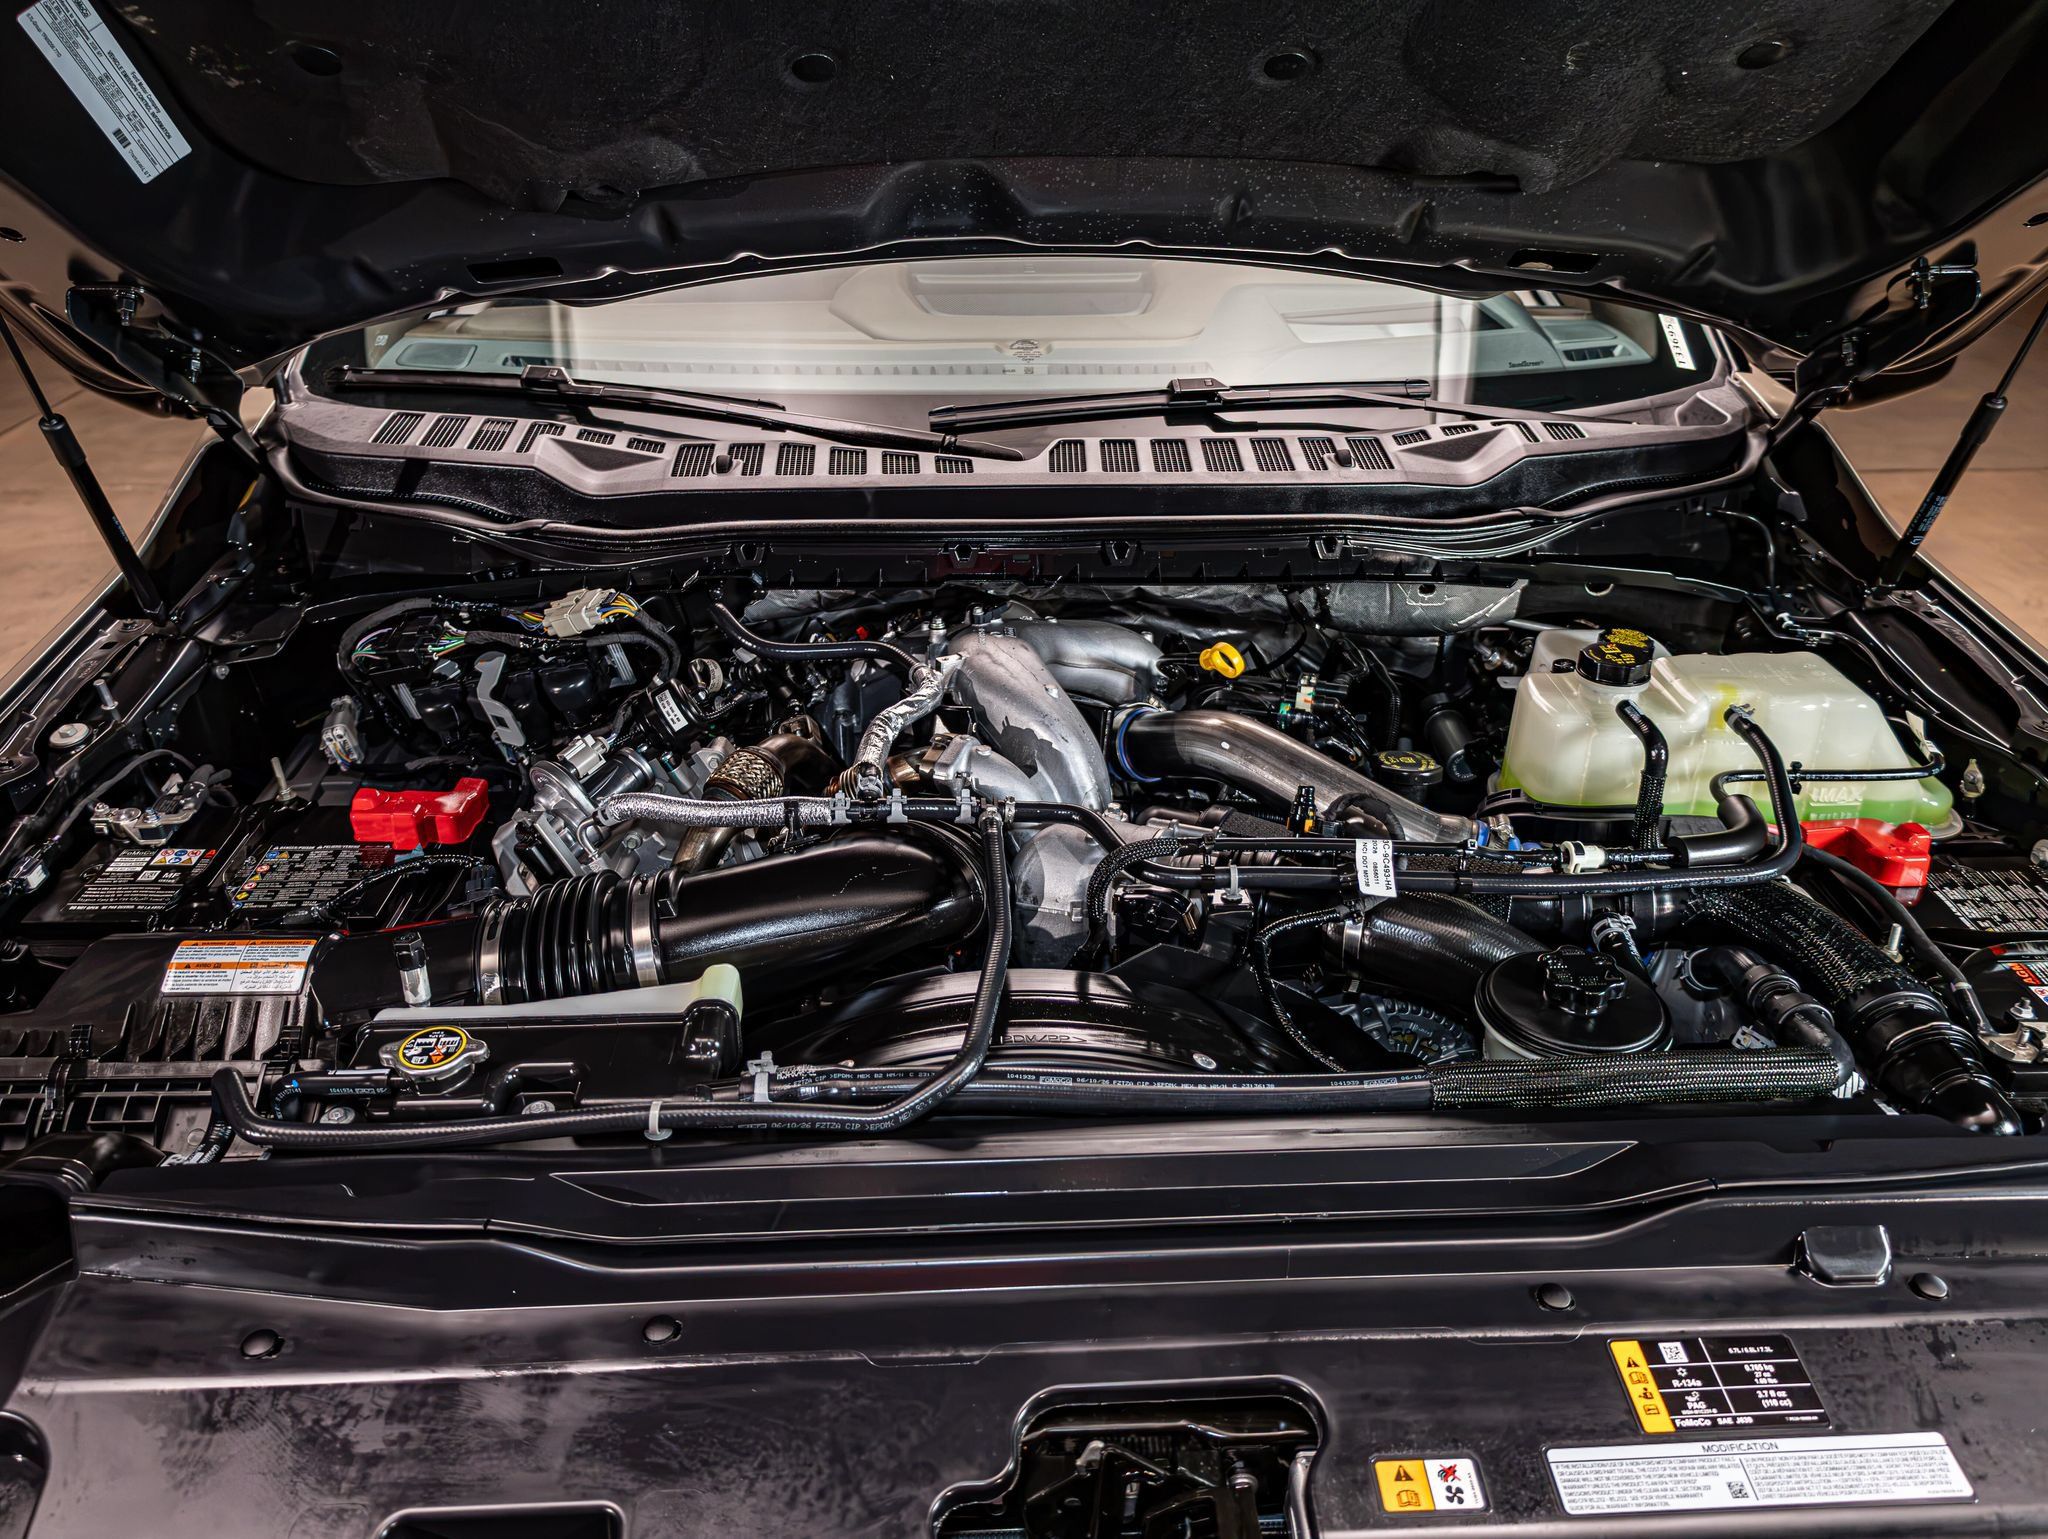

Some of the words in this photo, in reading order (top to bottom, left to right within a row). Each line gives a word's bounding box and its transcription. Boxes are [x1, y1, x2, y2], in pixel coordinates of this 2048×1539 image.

[1672, 1379, 1702, 1388] R-134a
[1687, 1401, 1706, 1409] PAG
[1779, 1398, 1792, 1407] cc)
[1674, 1418, 1711, 1427] FoMoCo
[1702, 1441, 1779, 1453] MODIFICATION
